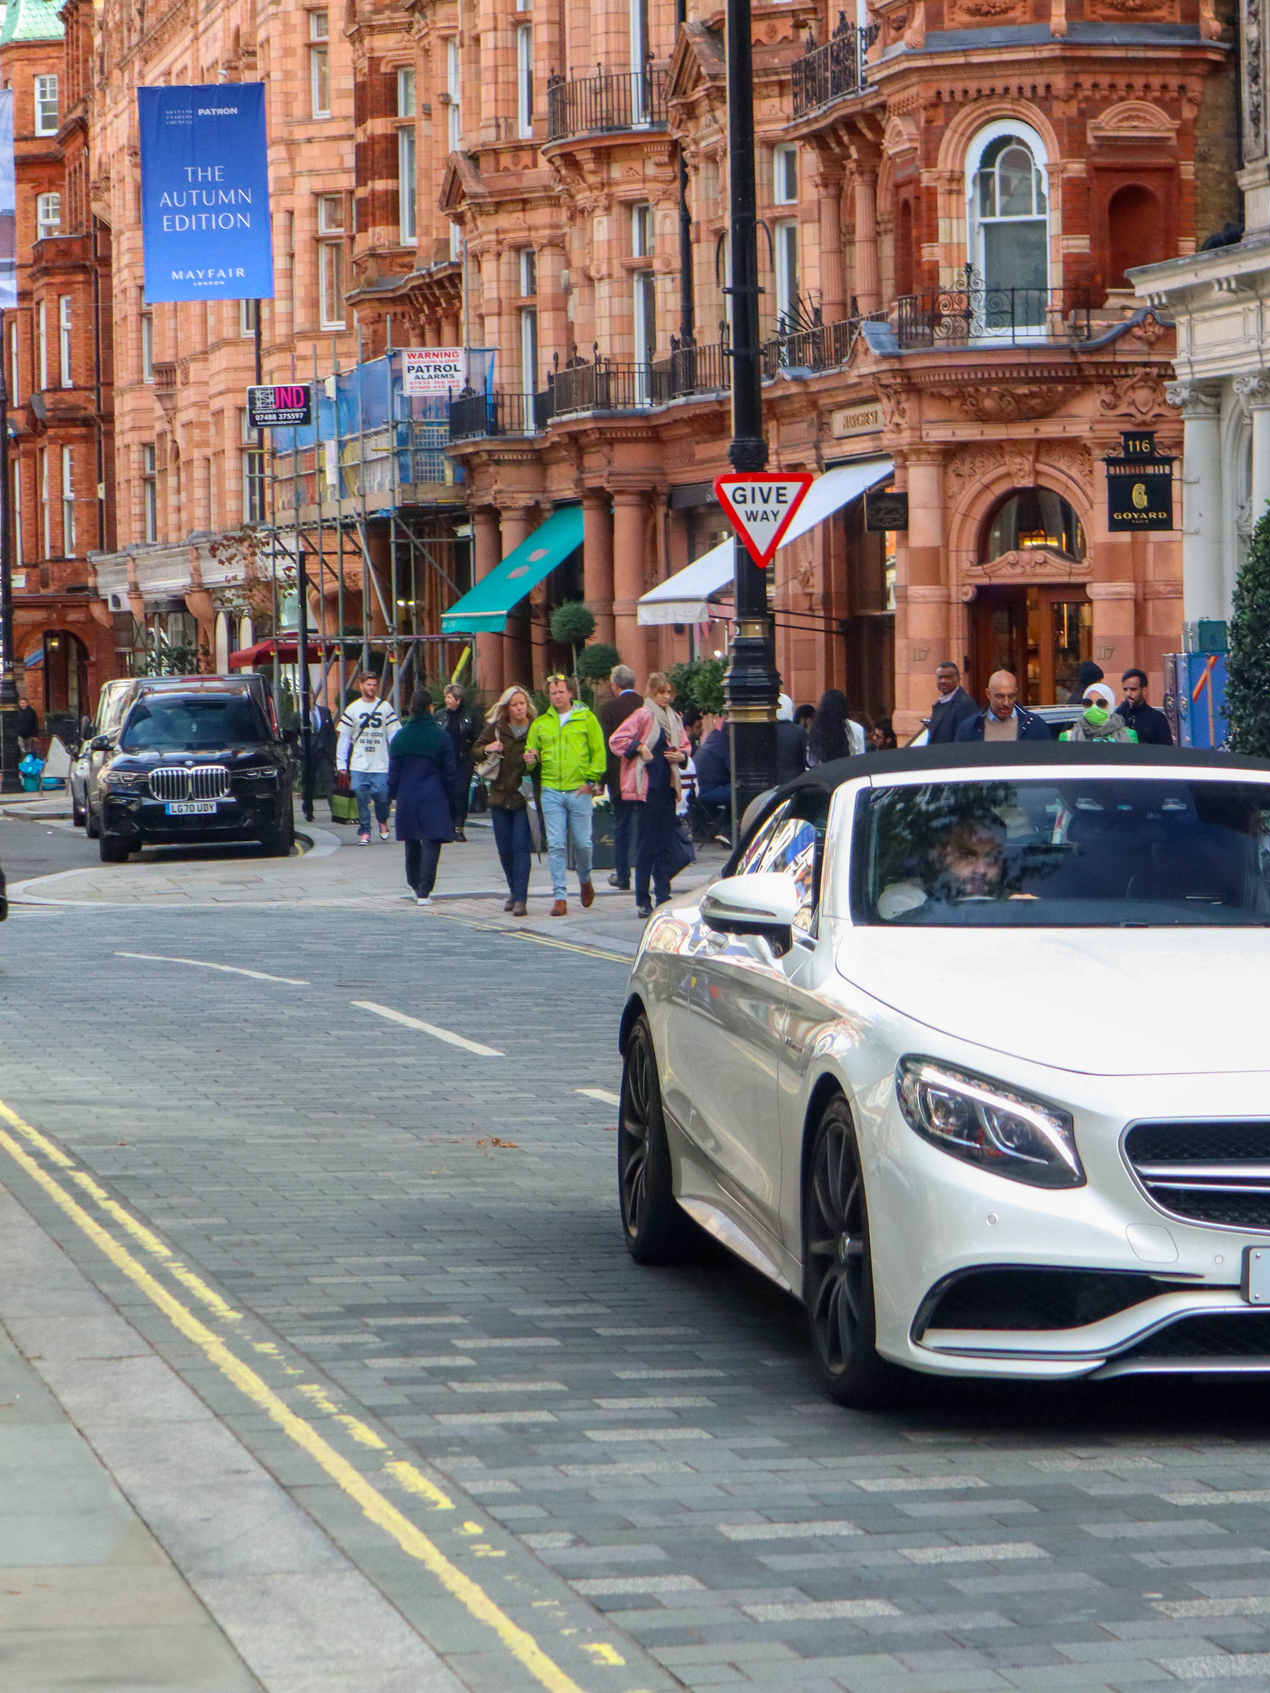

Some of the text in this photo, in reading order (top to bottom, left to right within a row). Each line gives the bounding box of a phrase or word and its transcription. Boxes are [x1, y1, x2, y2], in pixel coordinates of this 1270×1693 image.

[198, 107, 238, 116] PATRON
[183, 165, 225, 182] THE
[159, 188, 252, 208] AUTUMN
[163, 212, 251, 232] EDITION
[171, 267, 246, 280] MAYFAIR
[407, 351, 460, 360] WARNING
[407, 364, 461, 374] PATROL
[1127, 440, 1151, 452] 116
[731, 486, 788, 504] GIVE
[744, 510, 780, 522] WAY
[1113, 511, 1167, 520] GOYARD
[1096, 646, 1115, 660] 117
[359, 711, 382, 728] 25
[171, 803, 215, 813] LG70 UDY
